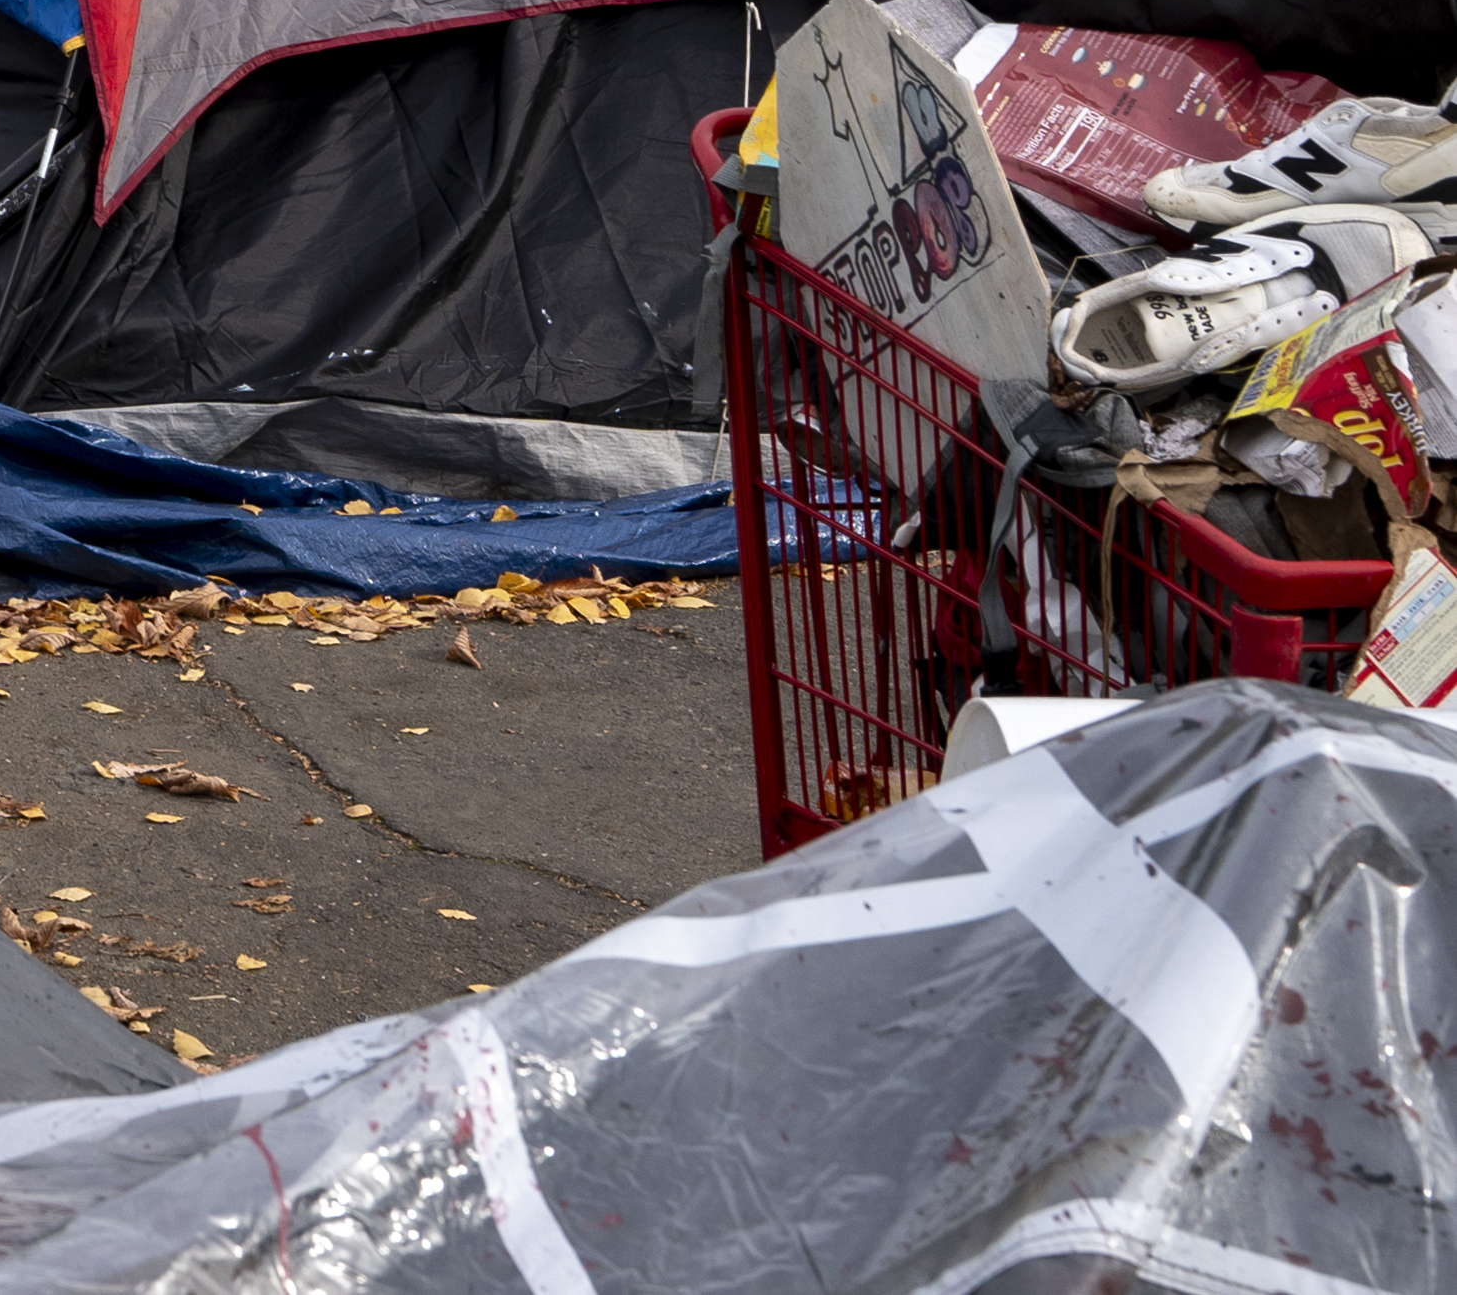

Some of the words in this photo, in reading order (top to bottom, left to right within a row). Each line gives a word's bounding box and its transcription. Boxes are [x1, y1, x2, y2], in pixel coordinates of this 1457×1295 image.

[1040, 103, 1065, 130] Facts
[1079, 109, 1101, 132] 190
[1145, 294, 1175, 320] 998
[1182, 313, 1201, 342] new
[1343, 371, 1373, 410] Stuffing
[1364, 383, 1381, 403] Mix
[1386, 390, 1428, 457] TURKEY
